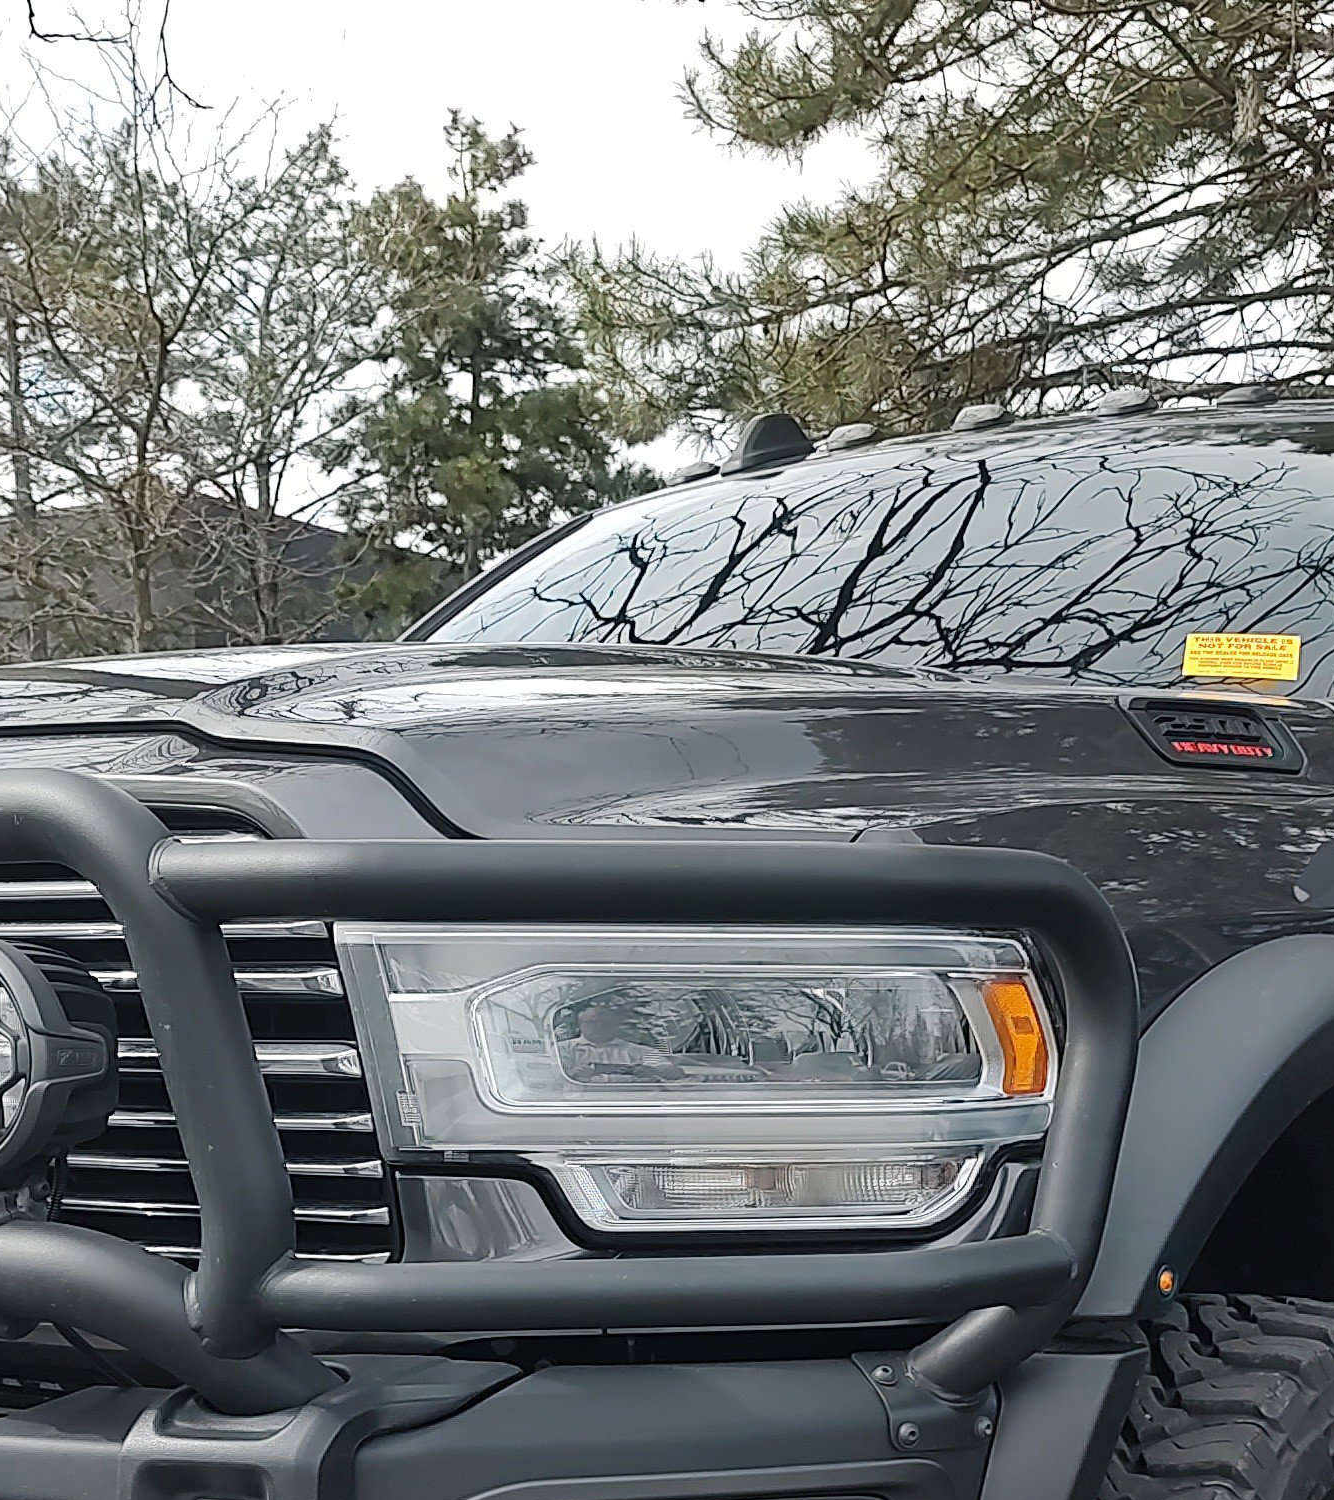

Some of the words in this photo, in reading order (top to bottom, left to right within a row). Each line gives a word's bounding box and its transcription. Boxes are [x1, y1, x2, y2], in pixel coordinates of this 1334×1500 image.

[1225, 636, 1278, 644] VEHICLE
[1152, 713, 1261, 741] 2500
[1170, 741, 1229, 755] HEAVY
[1229, 744, 1274, 758] DUTY
